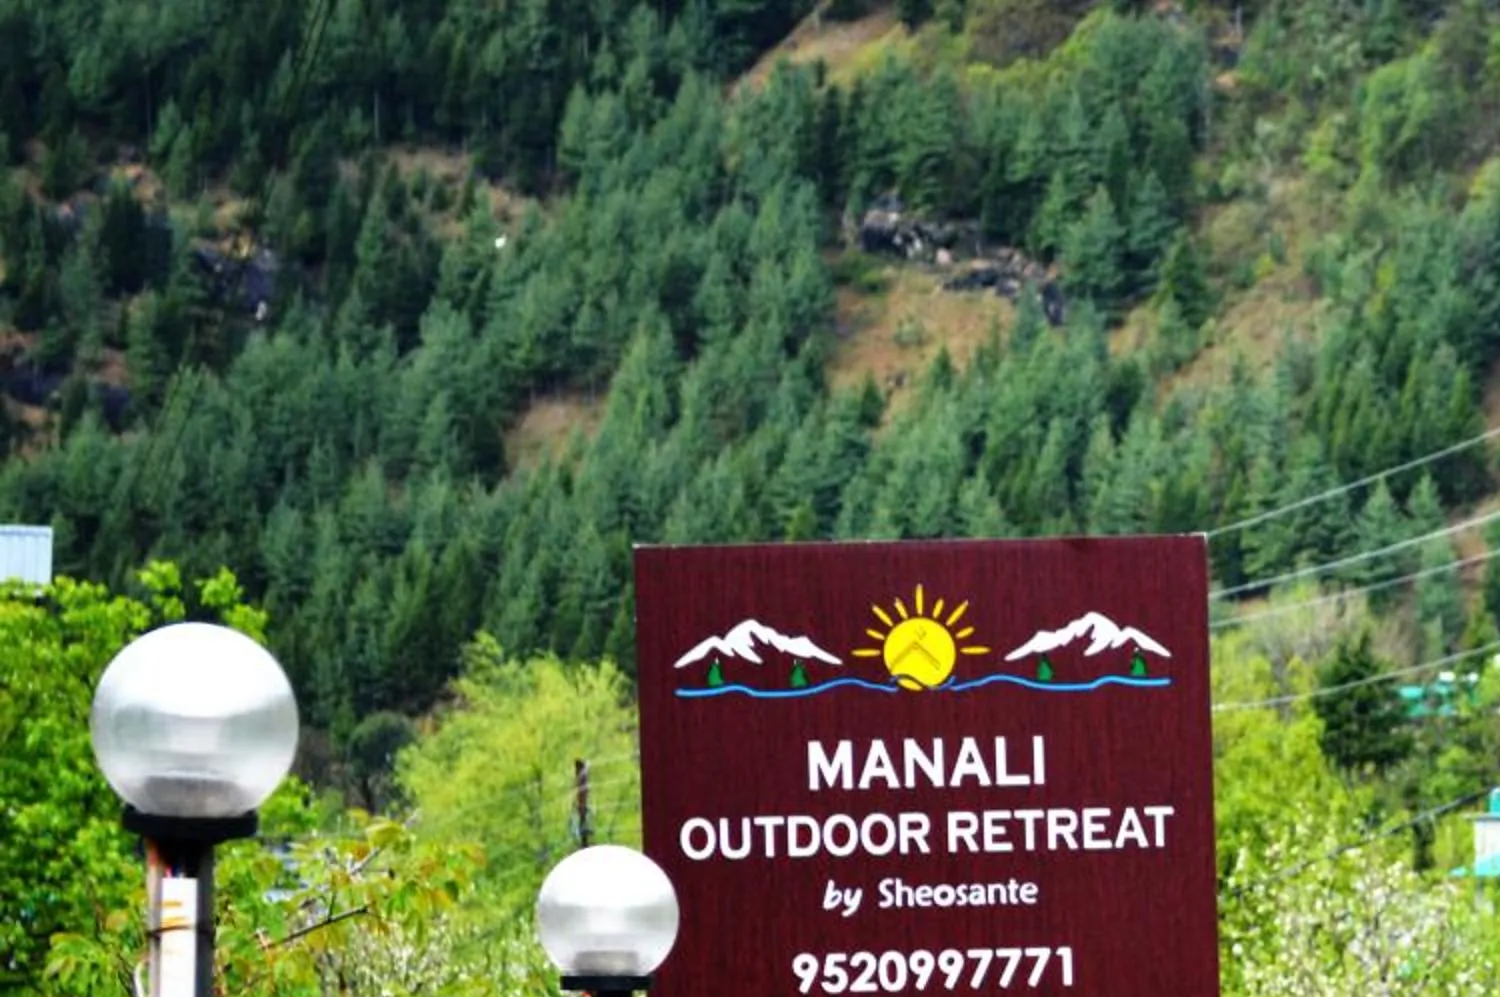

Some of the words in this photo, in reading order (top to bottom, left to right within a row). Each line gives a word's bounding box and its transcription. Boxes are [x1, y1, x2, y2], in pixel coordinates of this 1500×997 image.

[807, 735, 1045, 791] MANALI
[679, 812, 931, 861] OUTDOOR
[947, 805, 1175, 853] RETREAT
[822, 879, 863, 917] by
[878, 877, 1039, 909] Sheosante
[792, 946, 1073, 994] 9520997771
